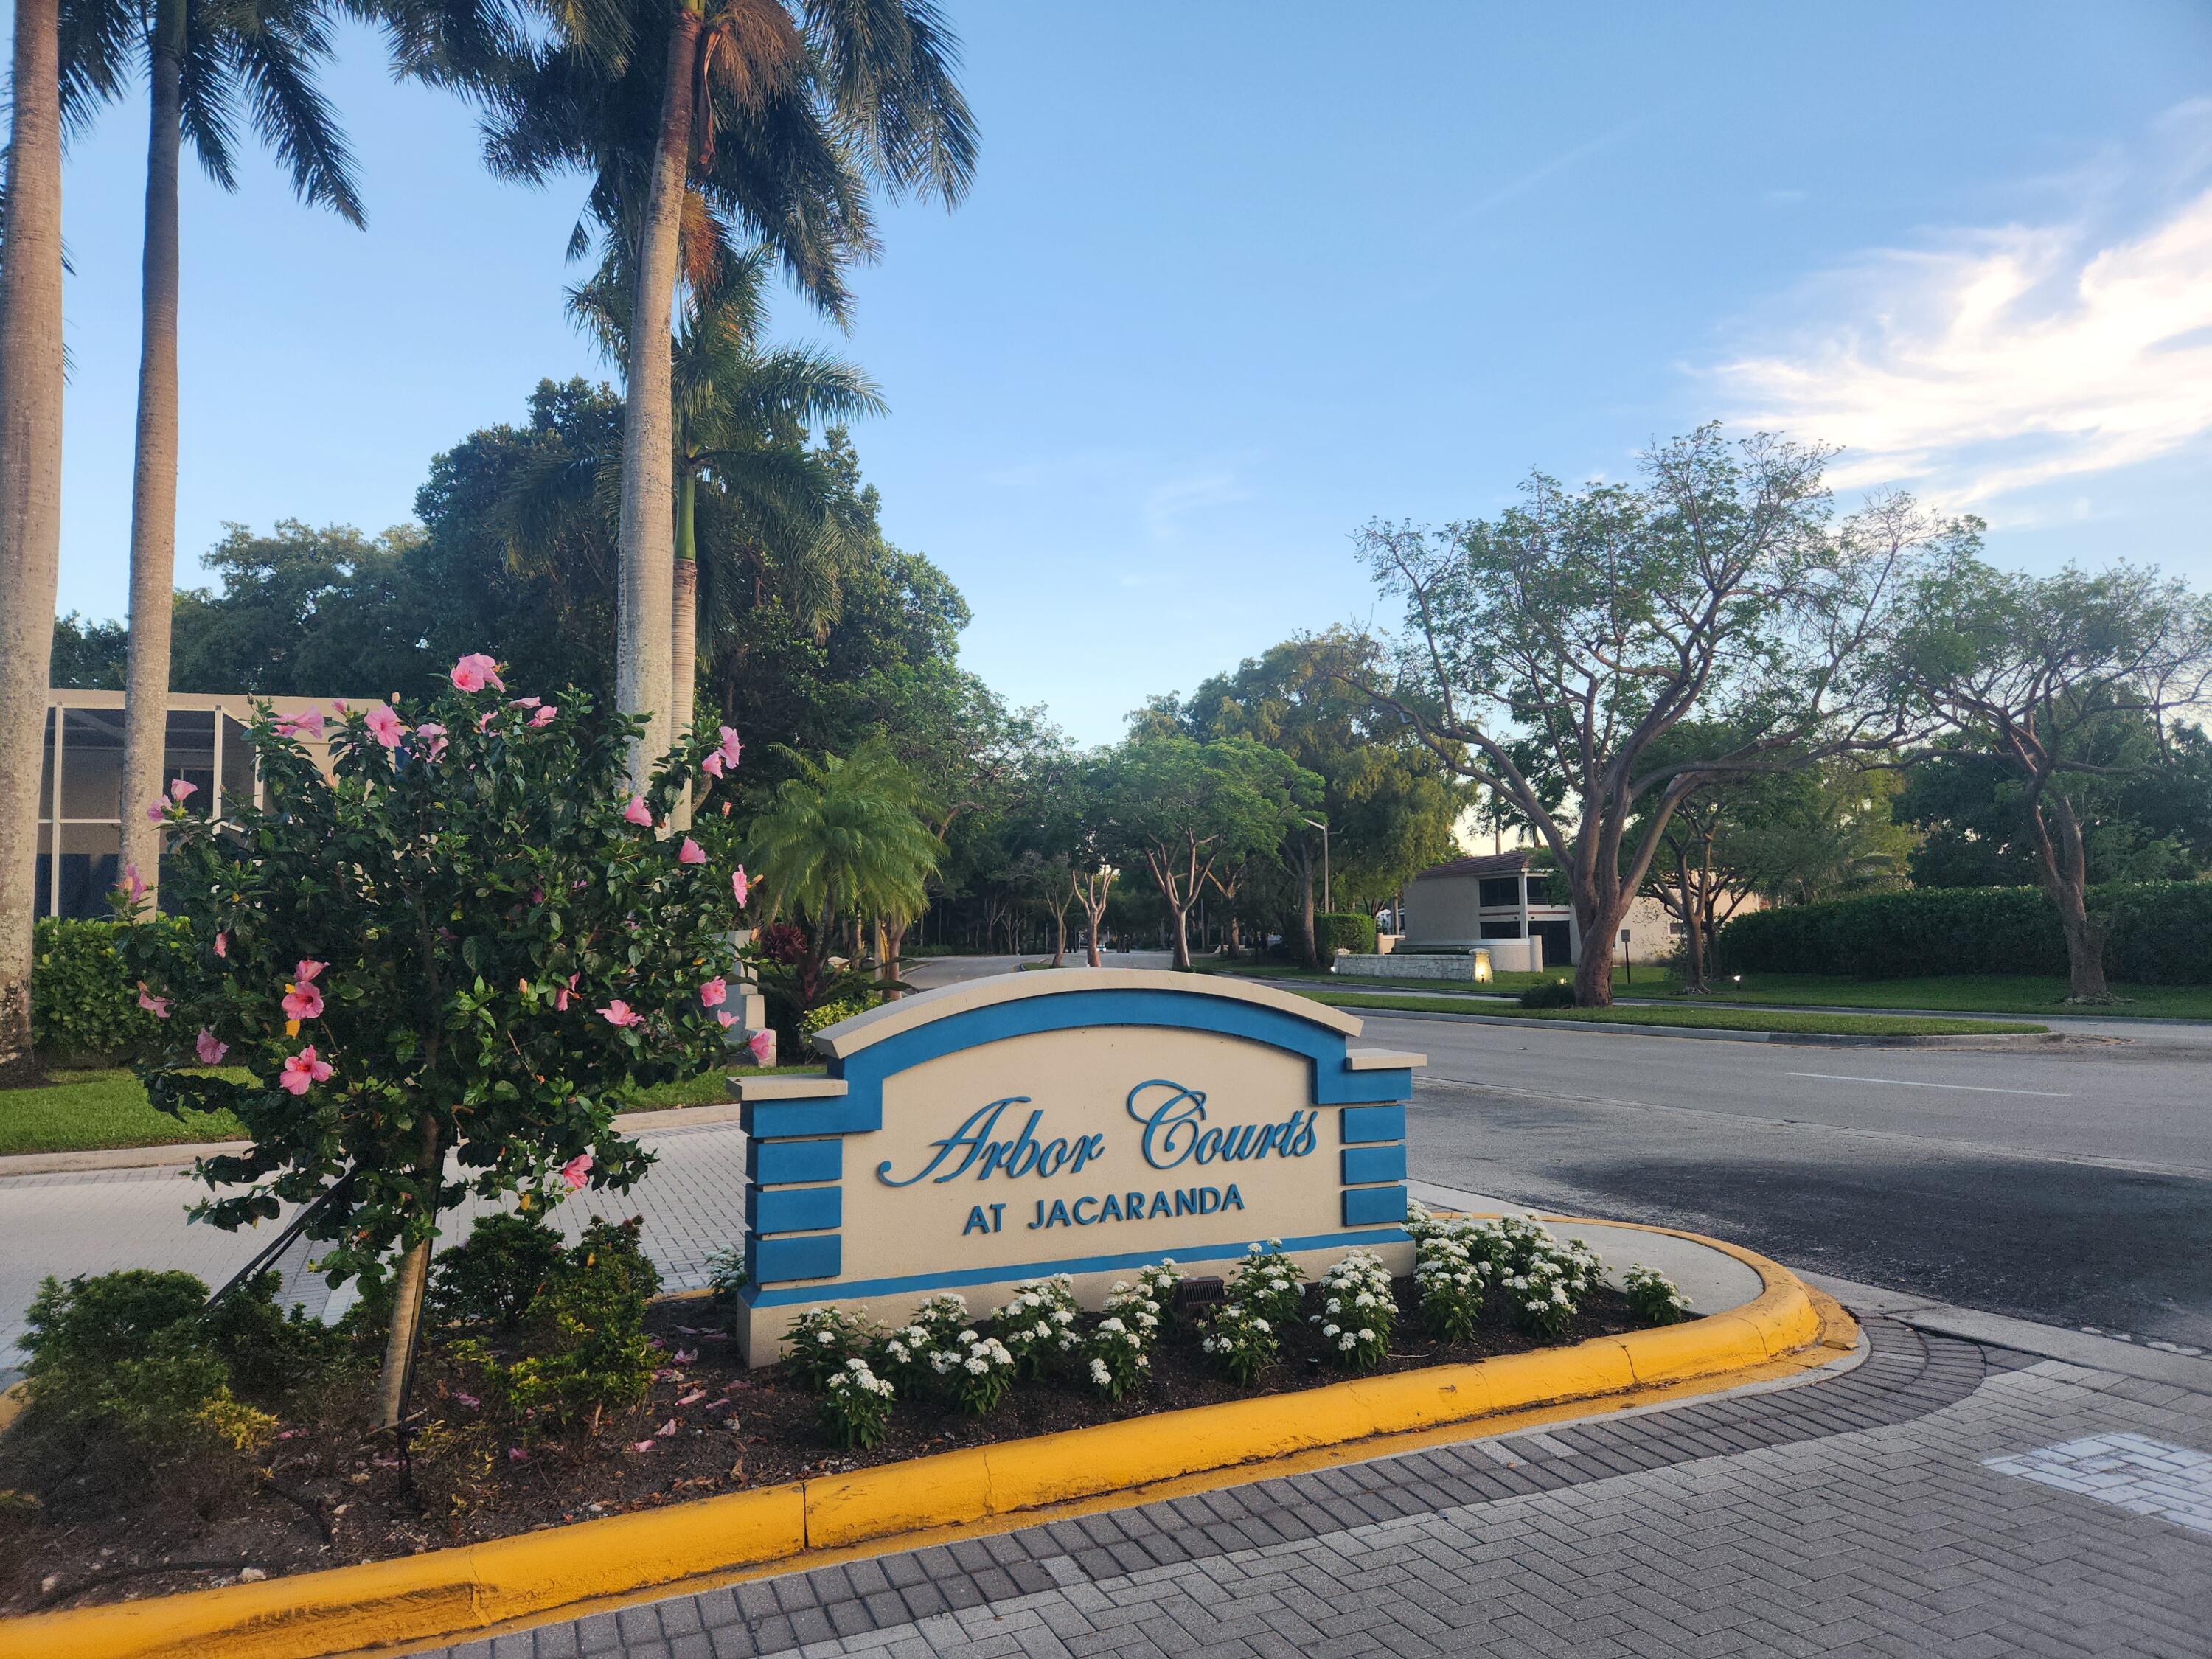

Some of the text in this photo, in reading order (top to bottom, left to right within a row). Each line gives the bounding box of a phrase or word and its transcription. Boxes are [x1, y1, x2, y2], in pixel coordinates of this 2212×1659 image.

[878, 1079, 1318, 1187] Arbor Courts
[963, 1183, 1245, 1235] AT JACARANDA
